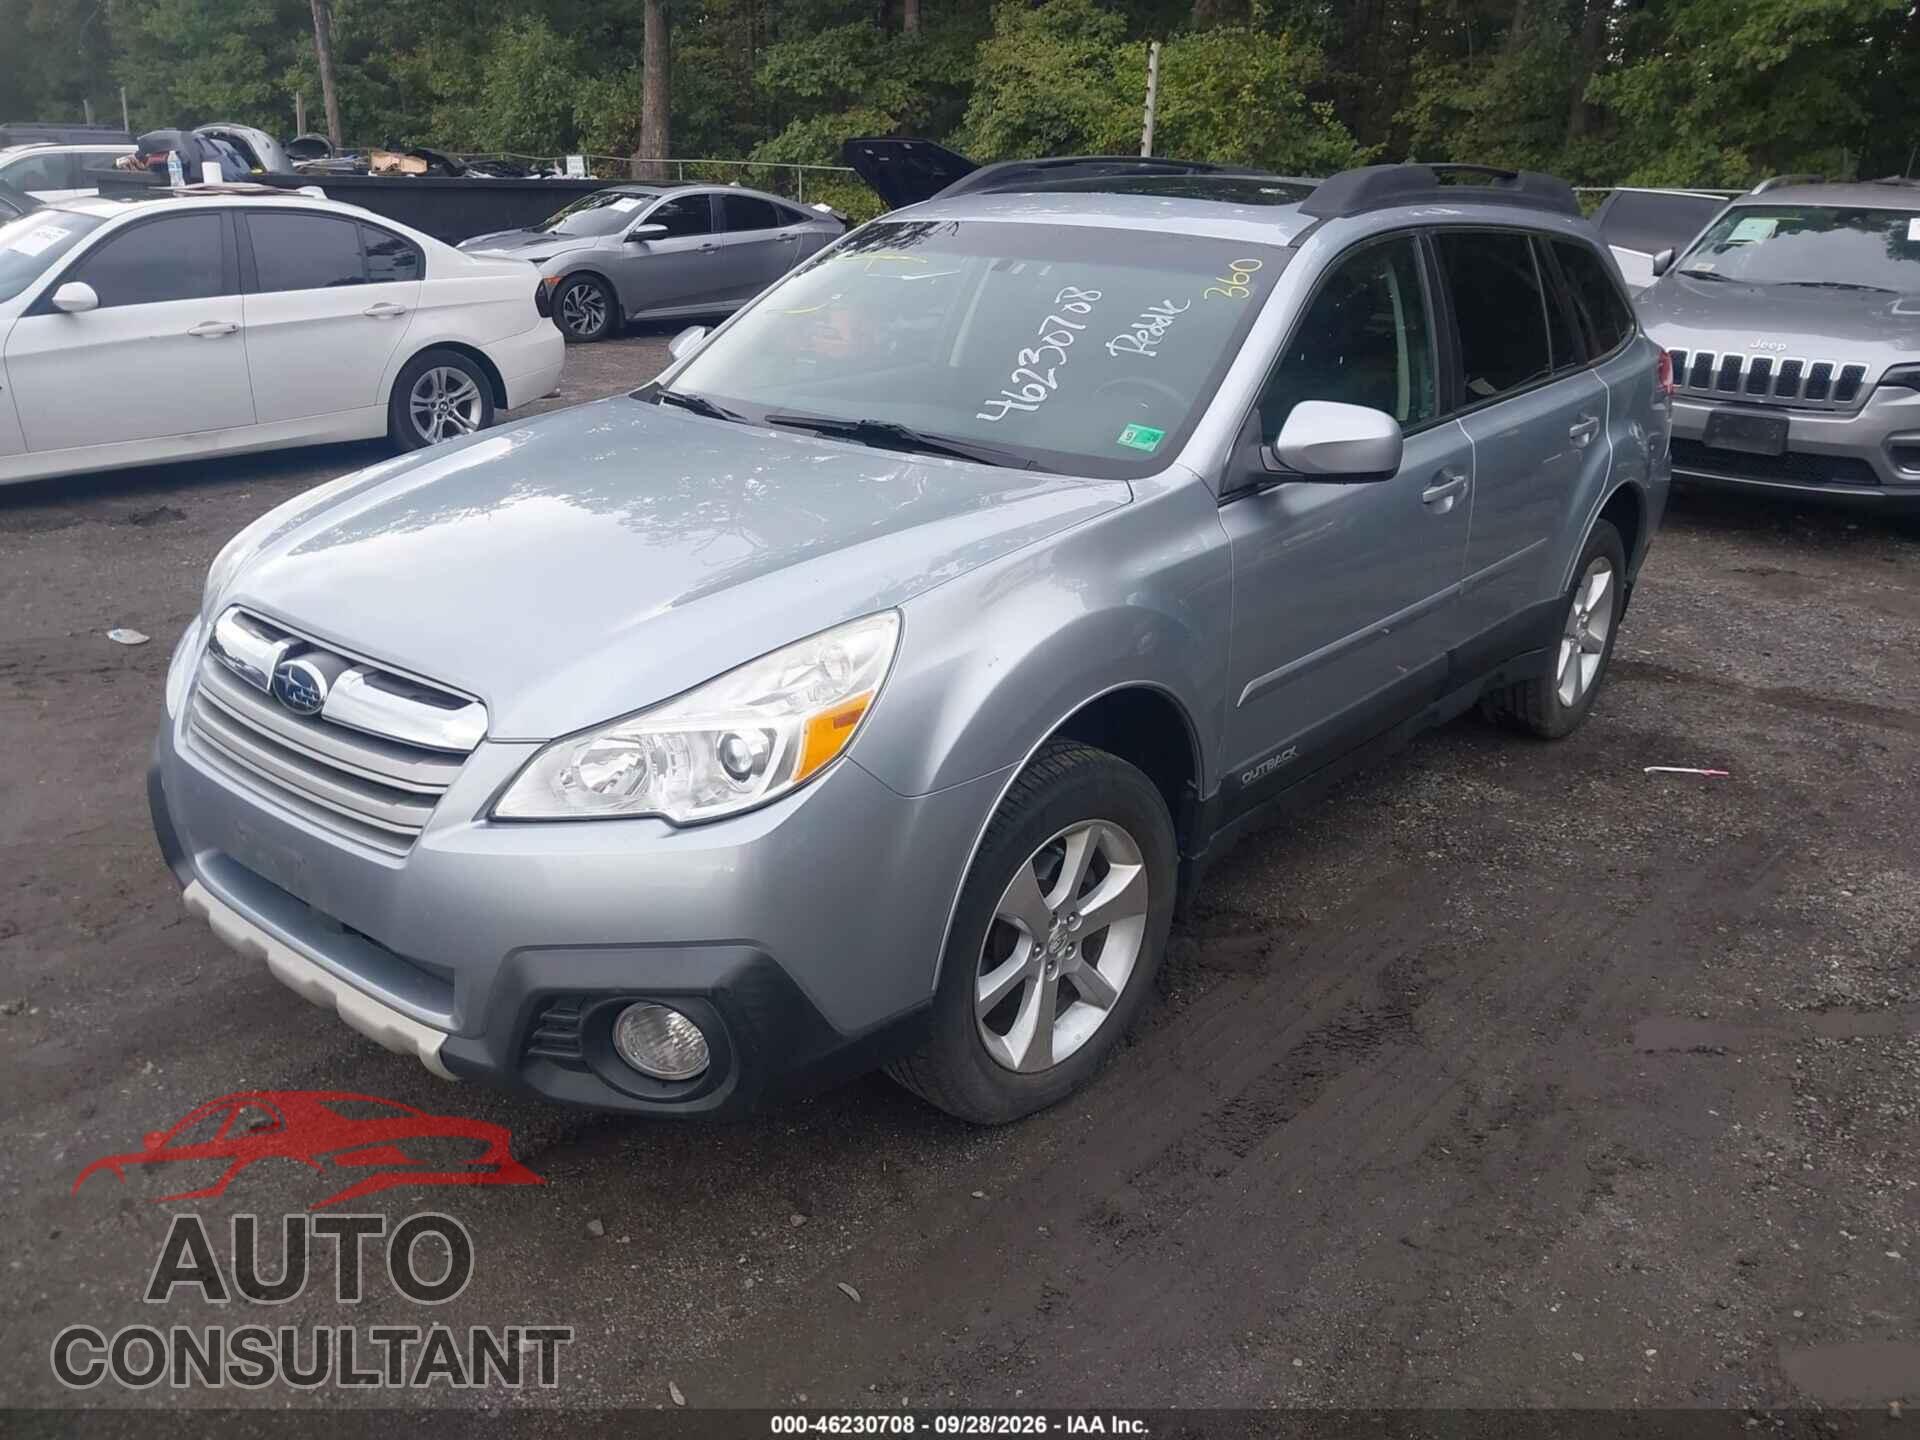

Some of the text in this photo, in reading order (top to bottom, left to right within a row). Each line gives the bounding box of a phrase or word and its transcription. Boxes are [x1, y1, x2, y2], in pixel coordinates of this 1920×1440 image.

[1203, 258, 1263, 300] 360
[976, 286, 1102, 421] 46230708
[1749, 338, 1786, 352] Jeep
[1241, 745, 1297, 785] OUTBACK
